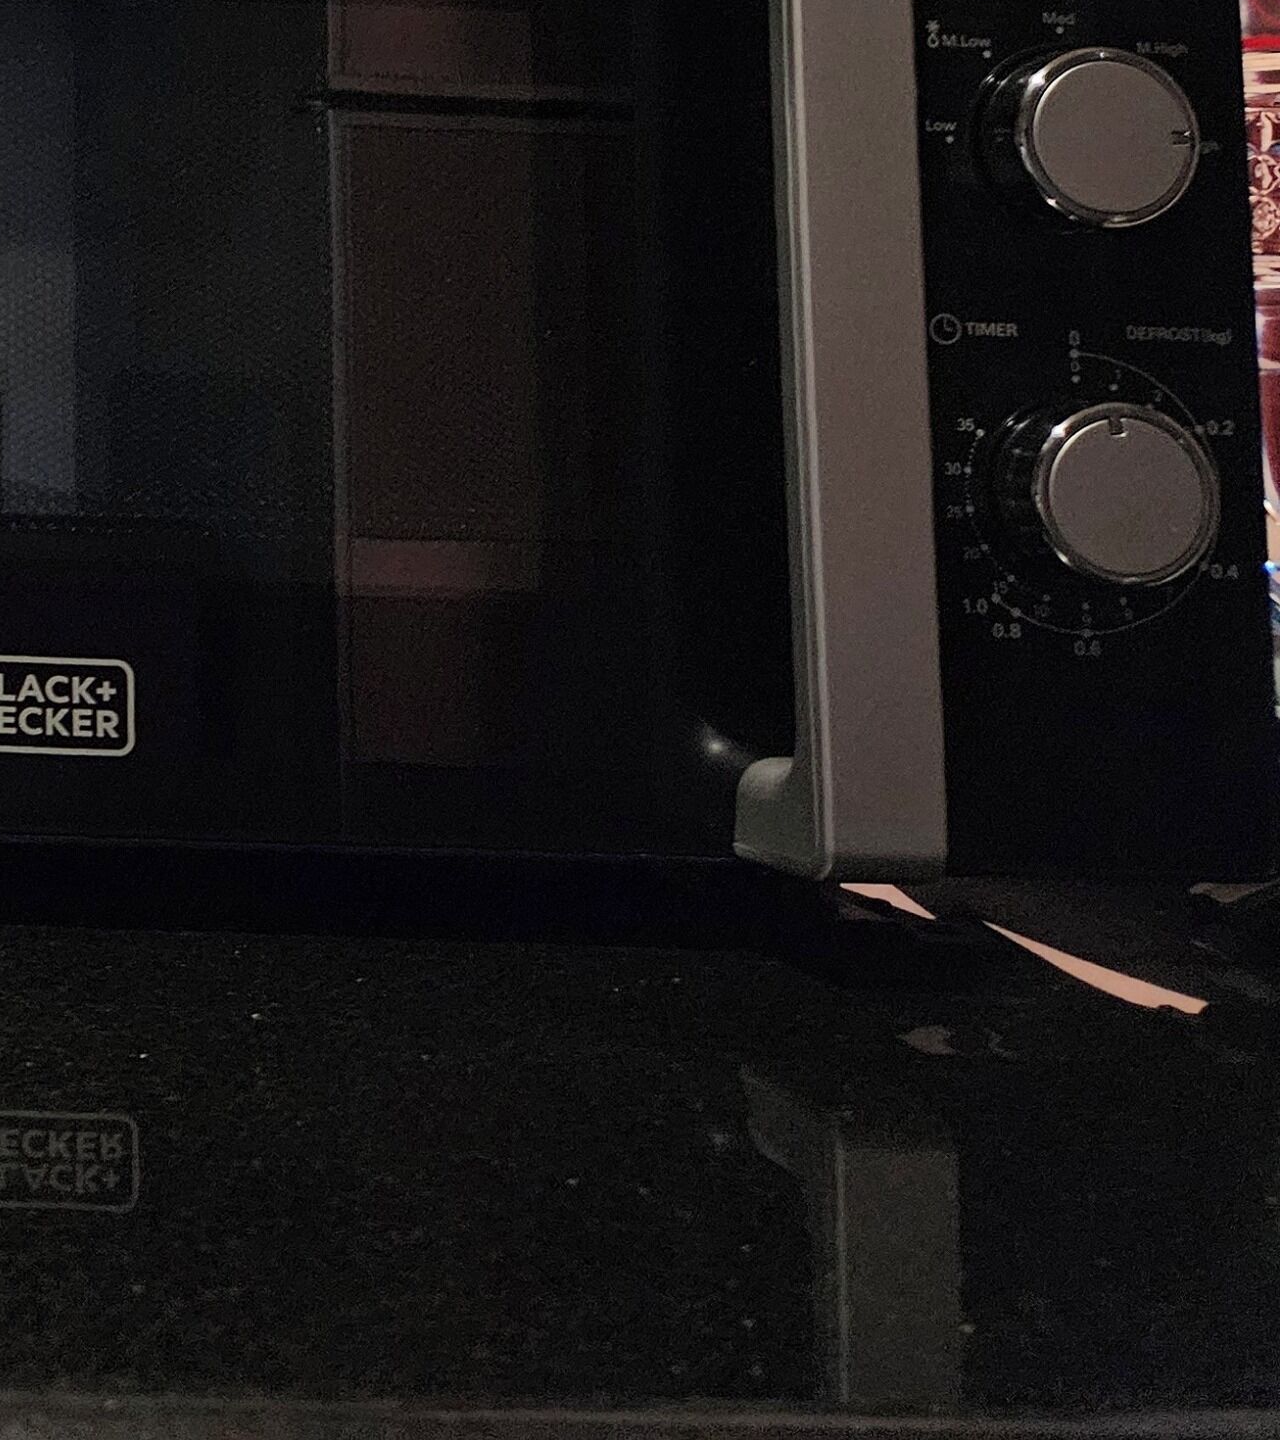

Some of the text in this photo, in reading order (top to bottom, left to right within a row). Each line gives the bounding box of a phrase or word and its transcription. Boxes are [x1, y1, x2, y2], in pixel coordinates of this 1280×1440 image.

[925, 119, 957, 132] Low
[965, 322, 1018, 338] TIMER
[956, 417, 975, 432] 35
[944, 461, 962, 476] 30
